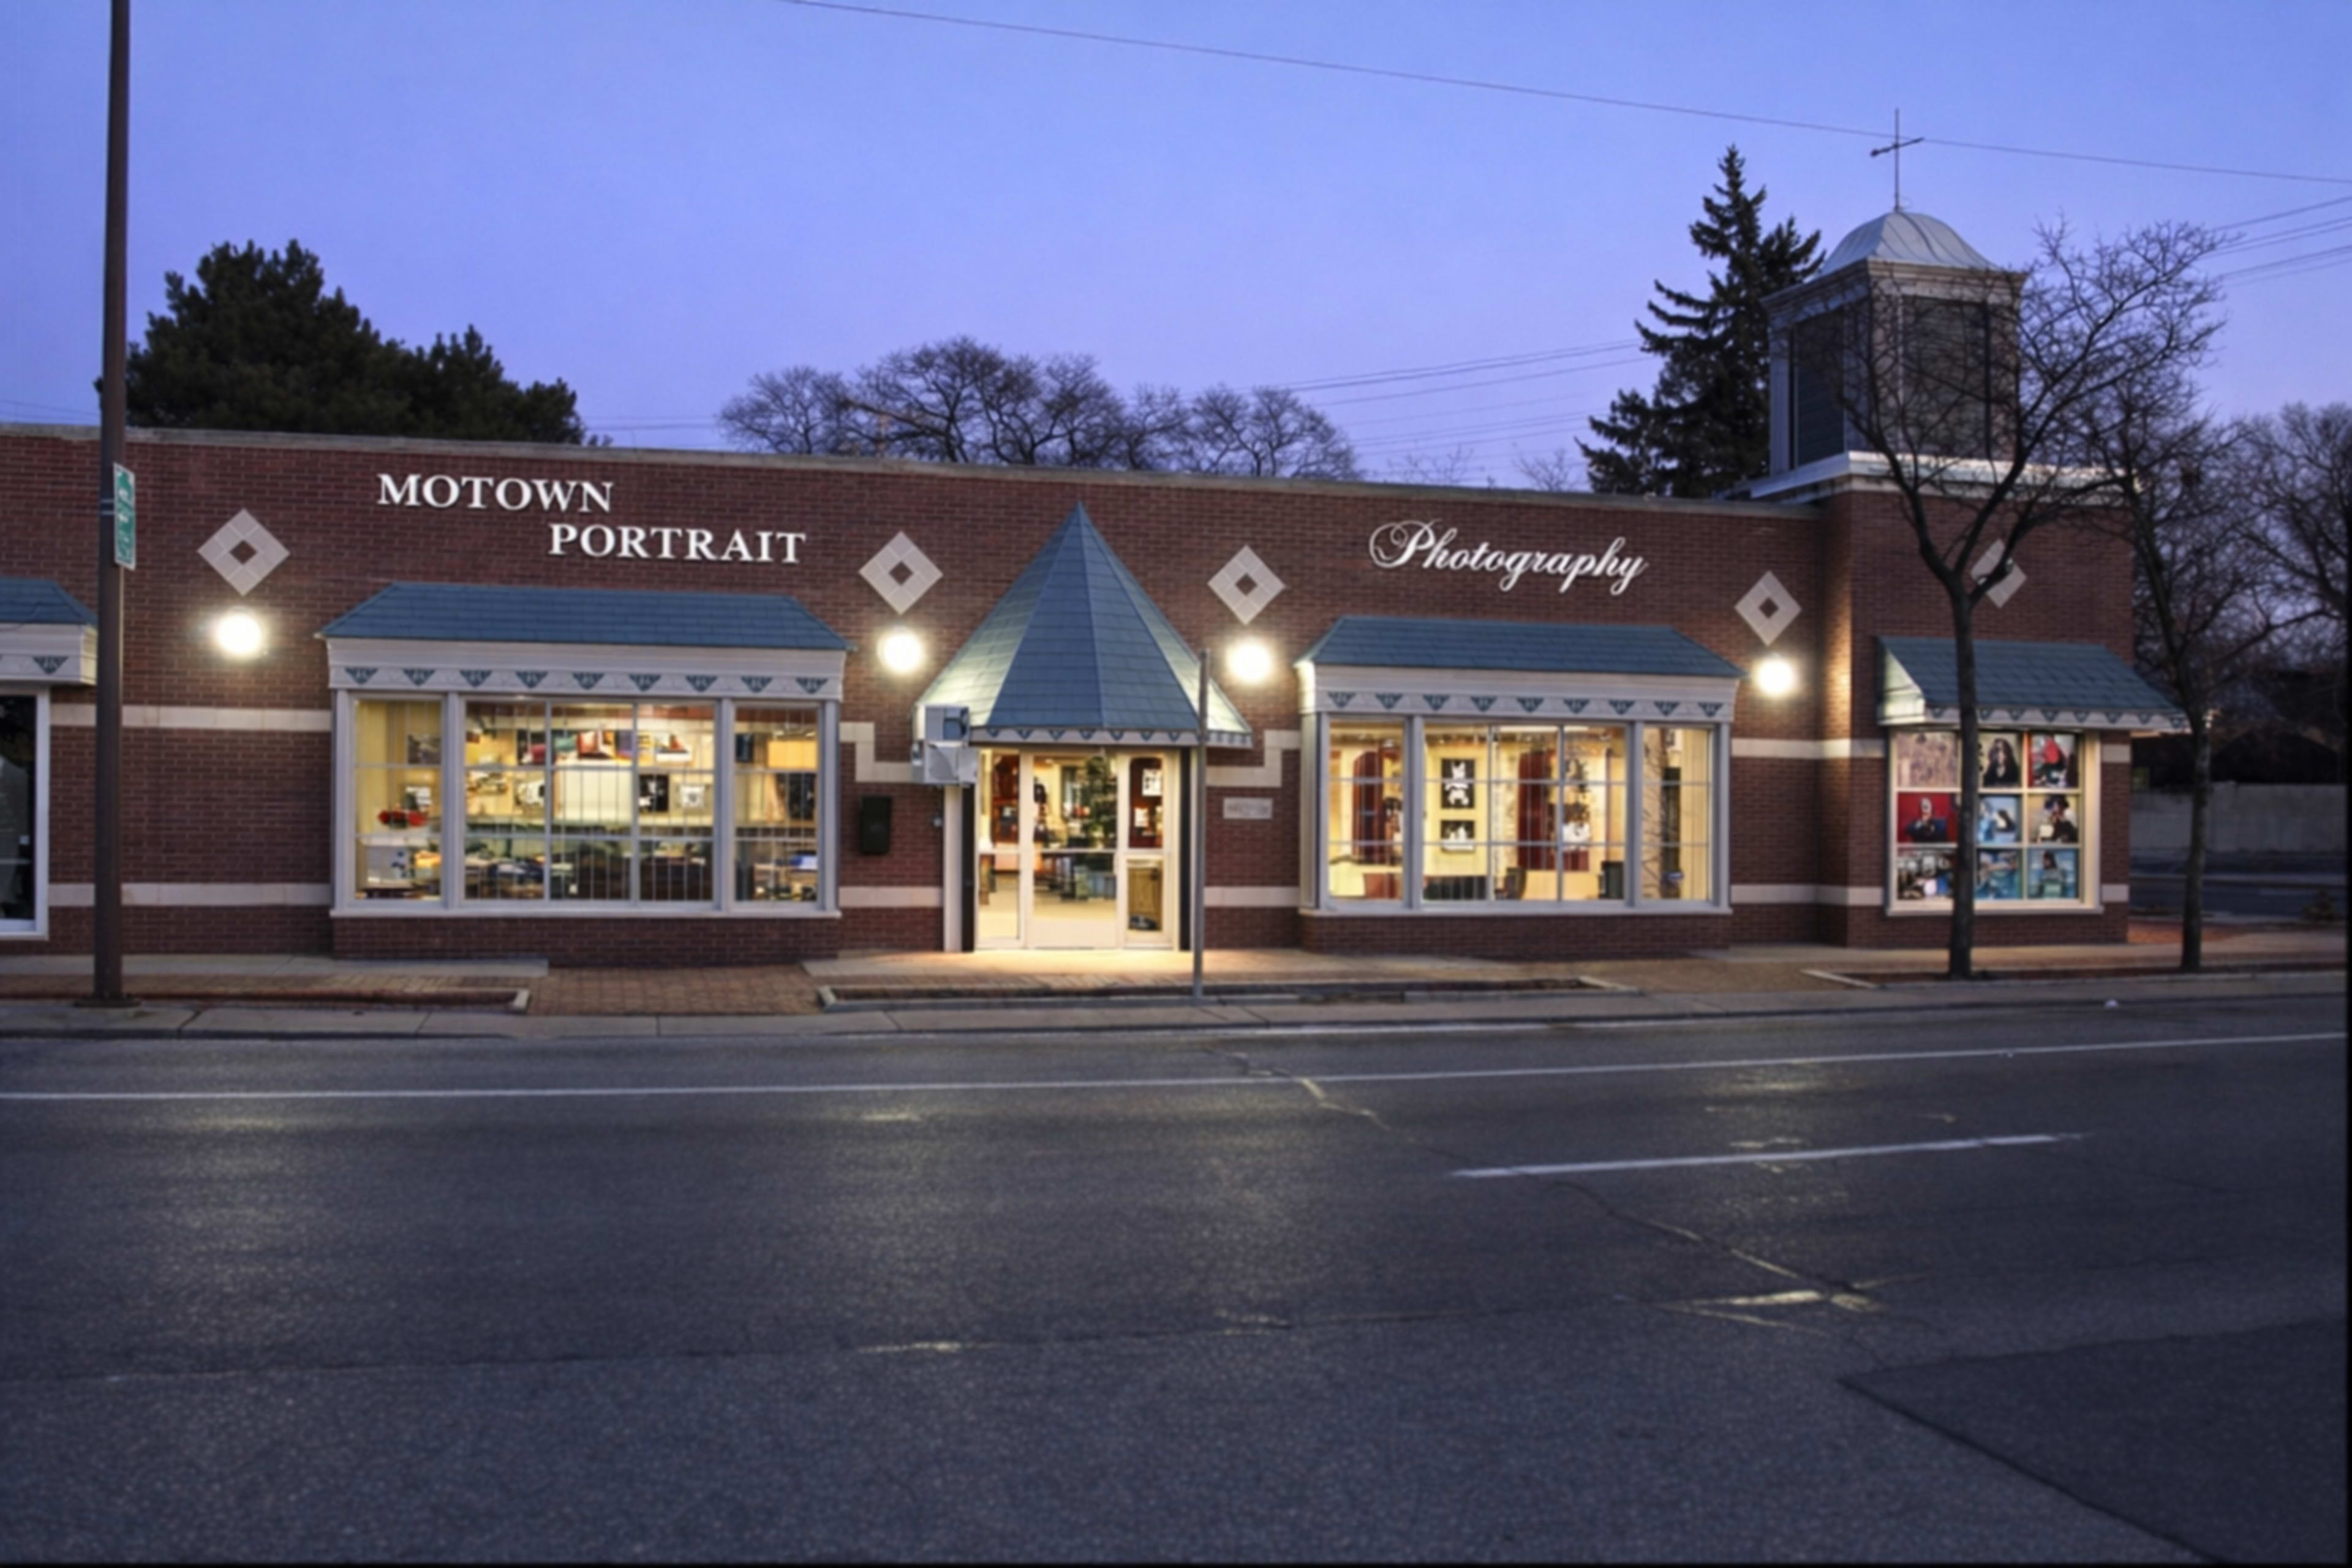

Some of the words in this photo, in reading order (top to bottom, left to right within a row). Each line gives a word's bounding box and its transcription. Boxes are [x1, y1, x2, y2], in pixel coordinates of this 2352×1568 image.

[377, 473, 613, 513] MOTOWN
[549, 524, 806, 563] PORTRAIT
[1369, 518, 1649, 595] Photography
